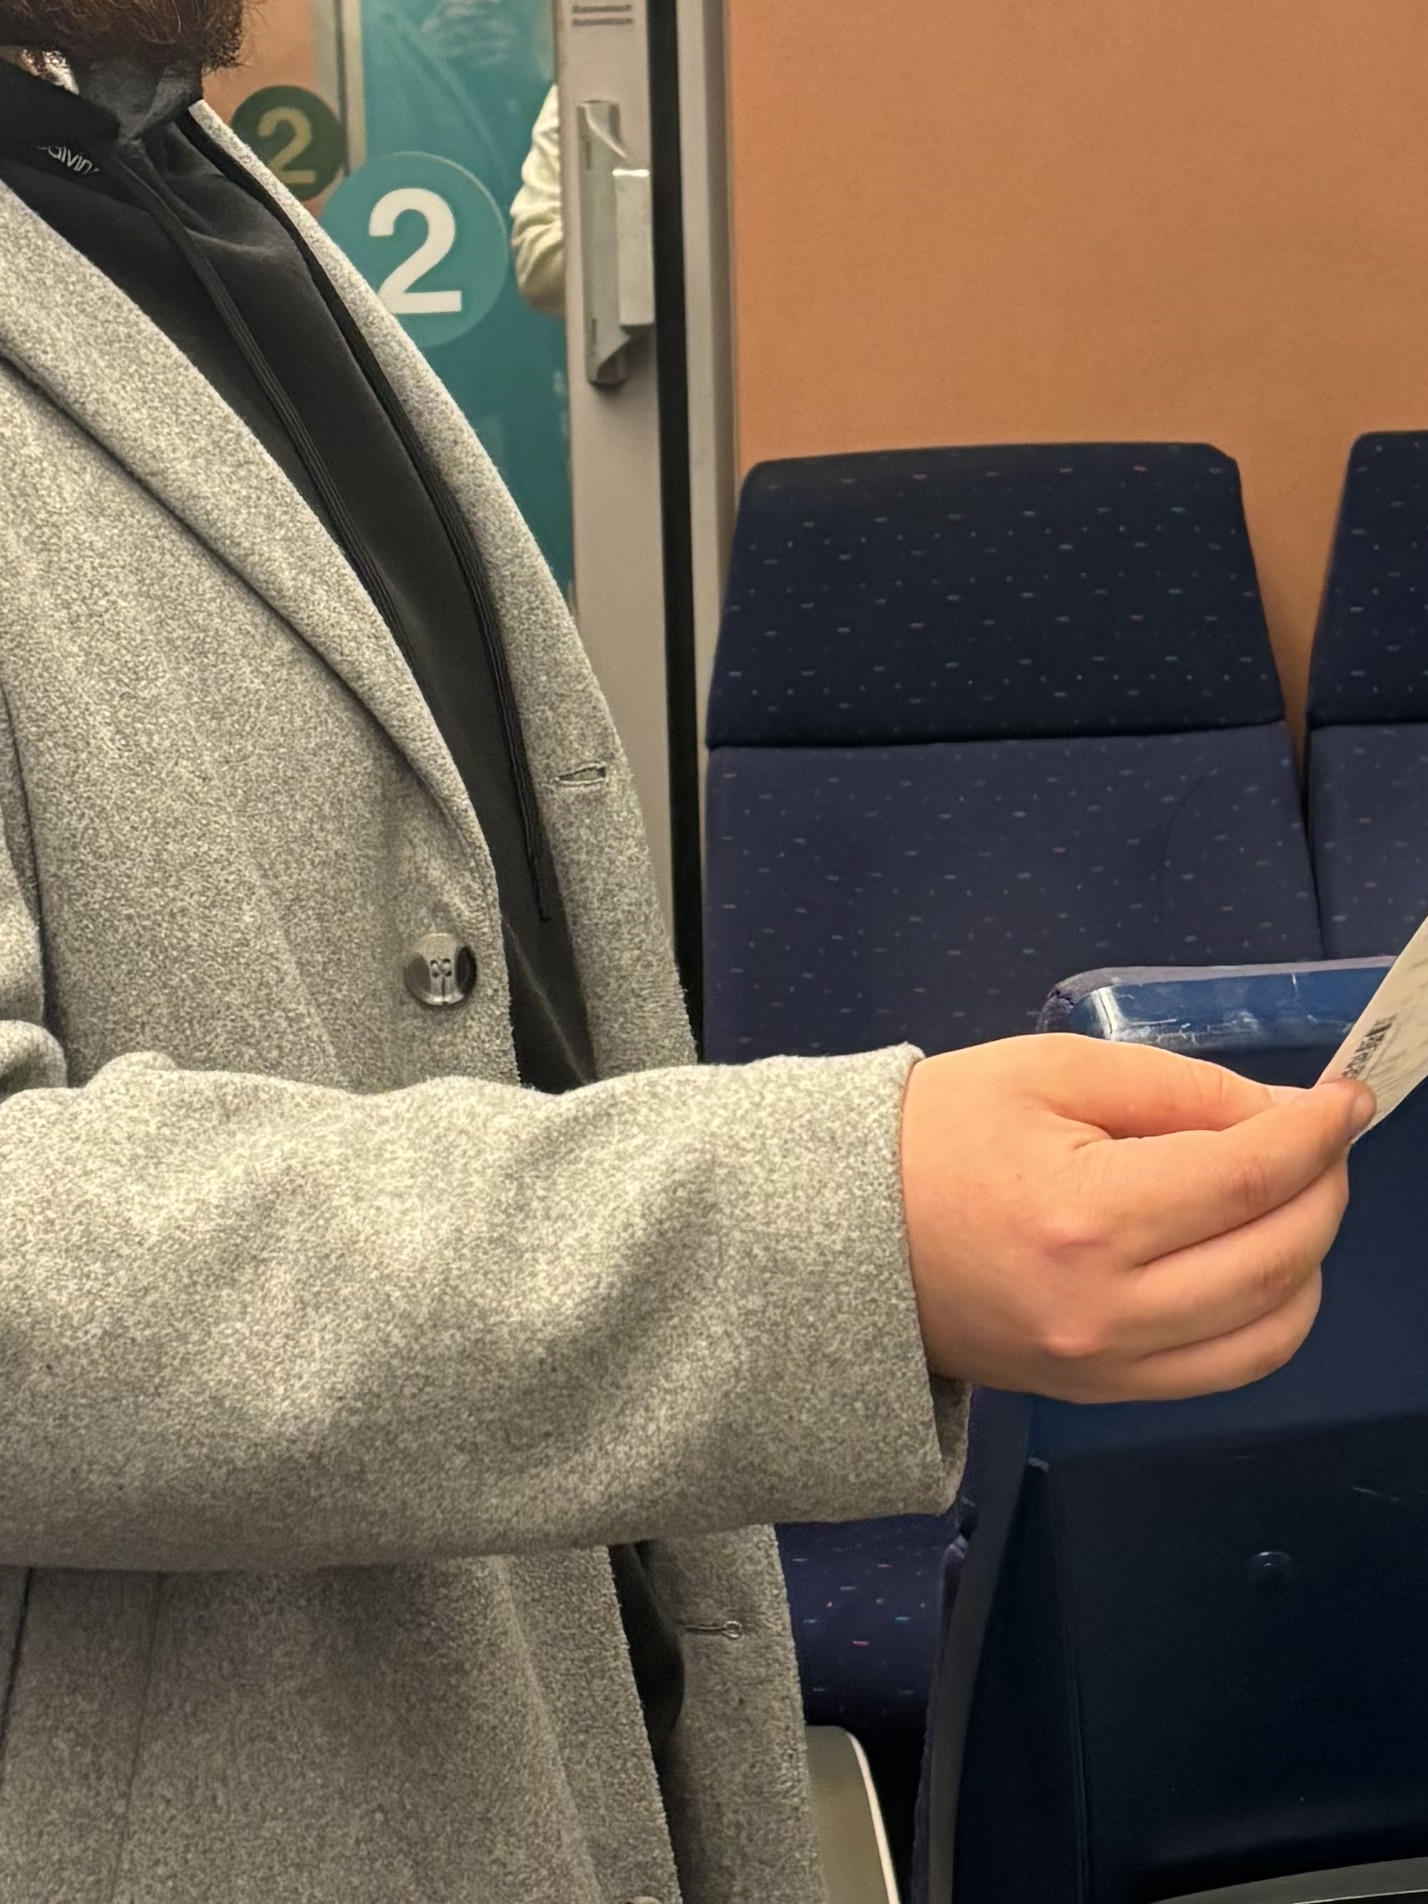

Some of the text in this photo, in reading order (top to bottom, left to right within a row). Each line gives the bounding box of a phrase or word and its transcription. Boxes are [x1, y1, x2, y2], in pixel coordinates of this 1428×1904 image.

[38, 145, 93, 175] alvin
[257, 106, 318, 184] 2
[368, 188, 462, 315] 2
